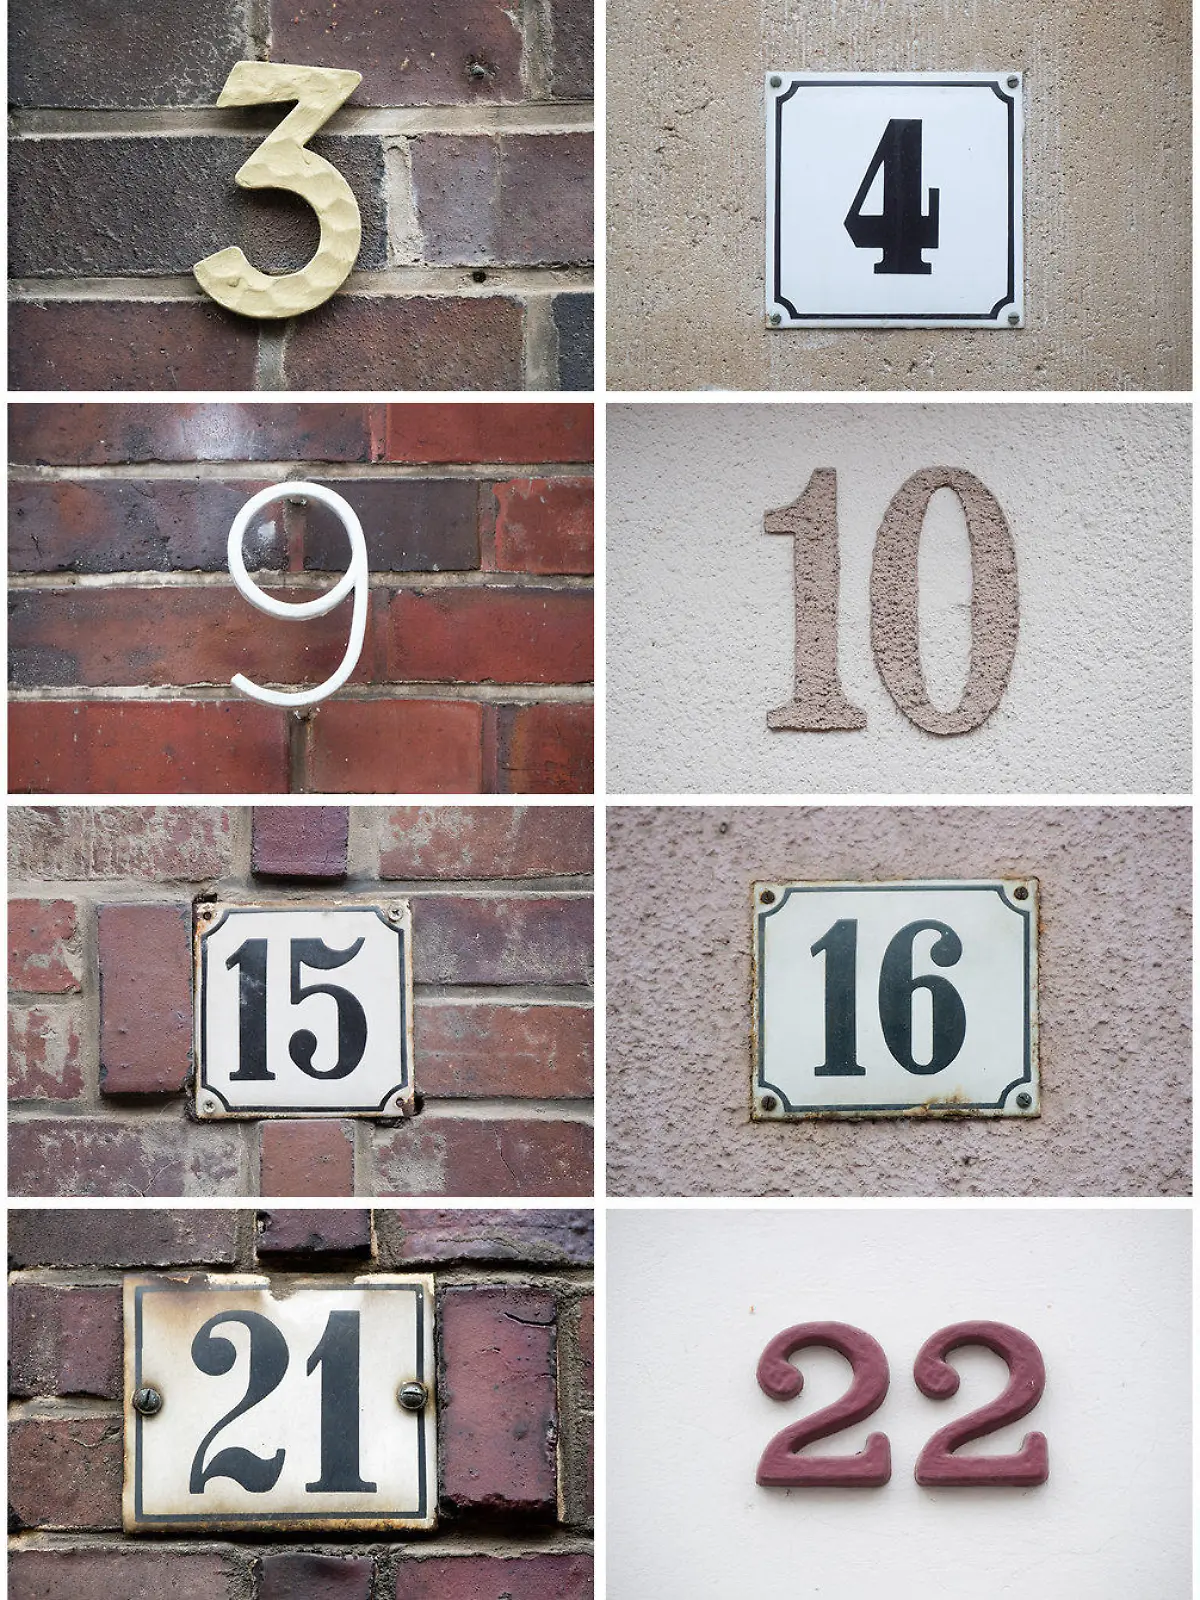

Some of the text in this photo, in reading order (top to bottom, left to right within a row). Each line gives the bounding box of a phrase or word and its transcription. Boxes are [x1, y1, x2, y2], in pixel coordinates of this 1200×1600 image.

[193, 60, 363, 320] 3
[844, 118, 940, 275] 4
[227, 480, 367, 706] 9
[763, 466, 1020, 735] 10
[226, 937, 367, 1081] 15
[810, 918, 966, 1076] 16
[190, 1310, 378, 1494] 21
[756, 1320, 1049, 1488] 22
